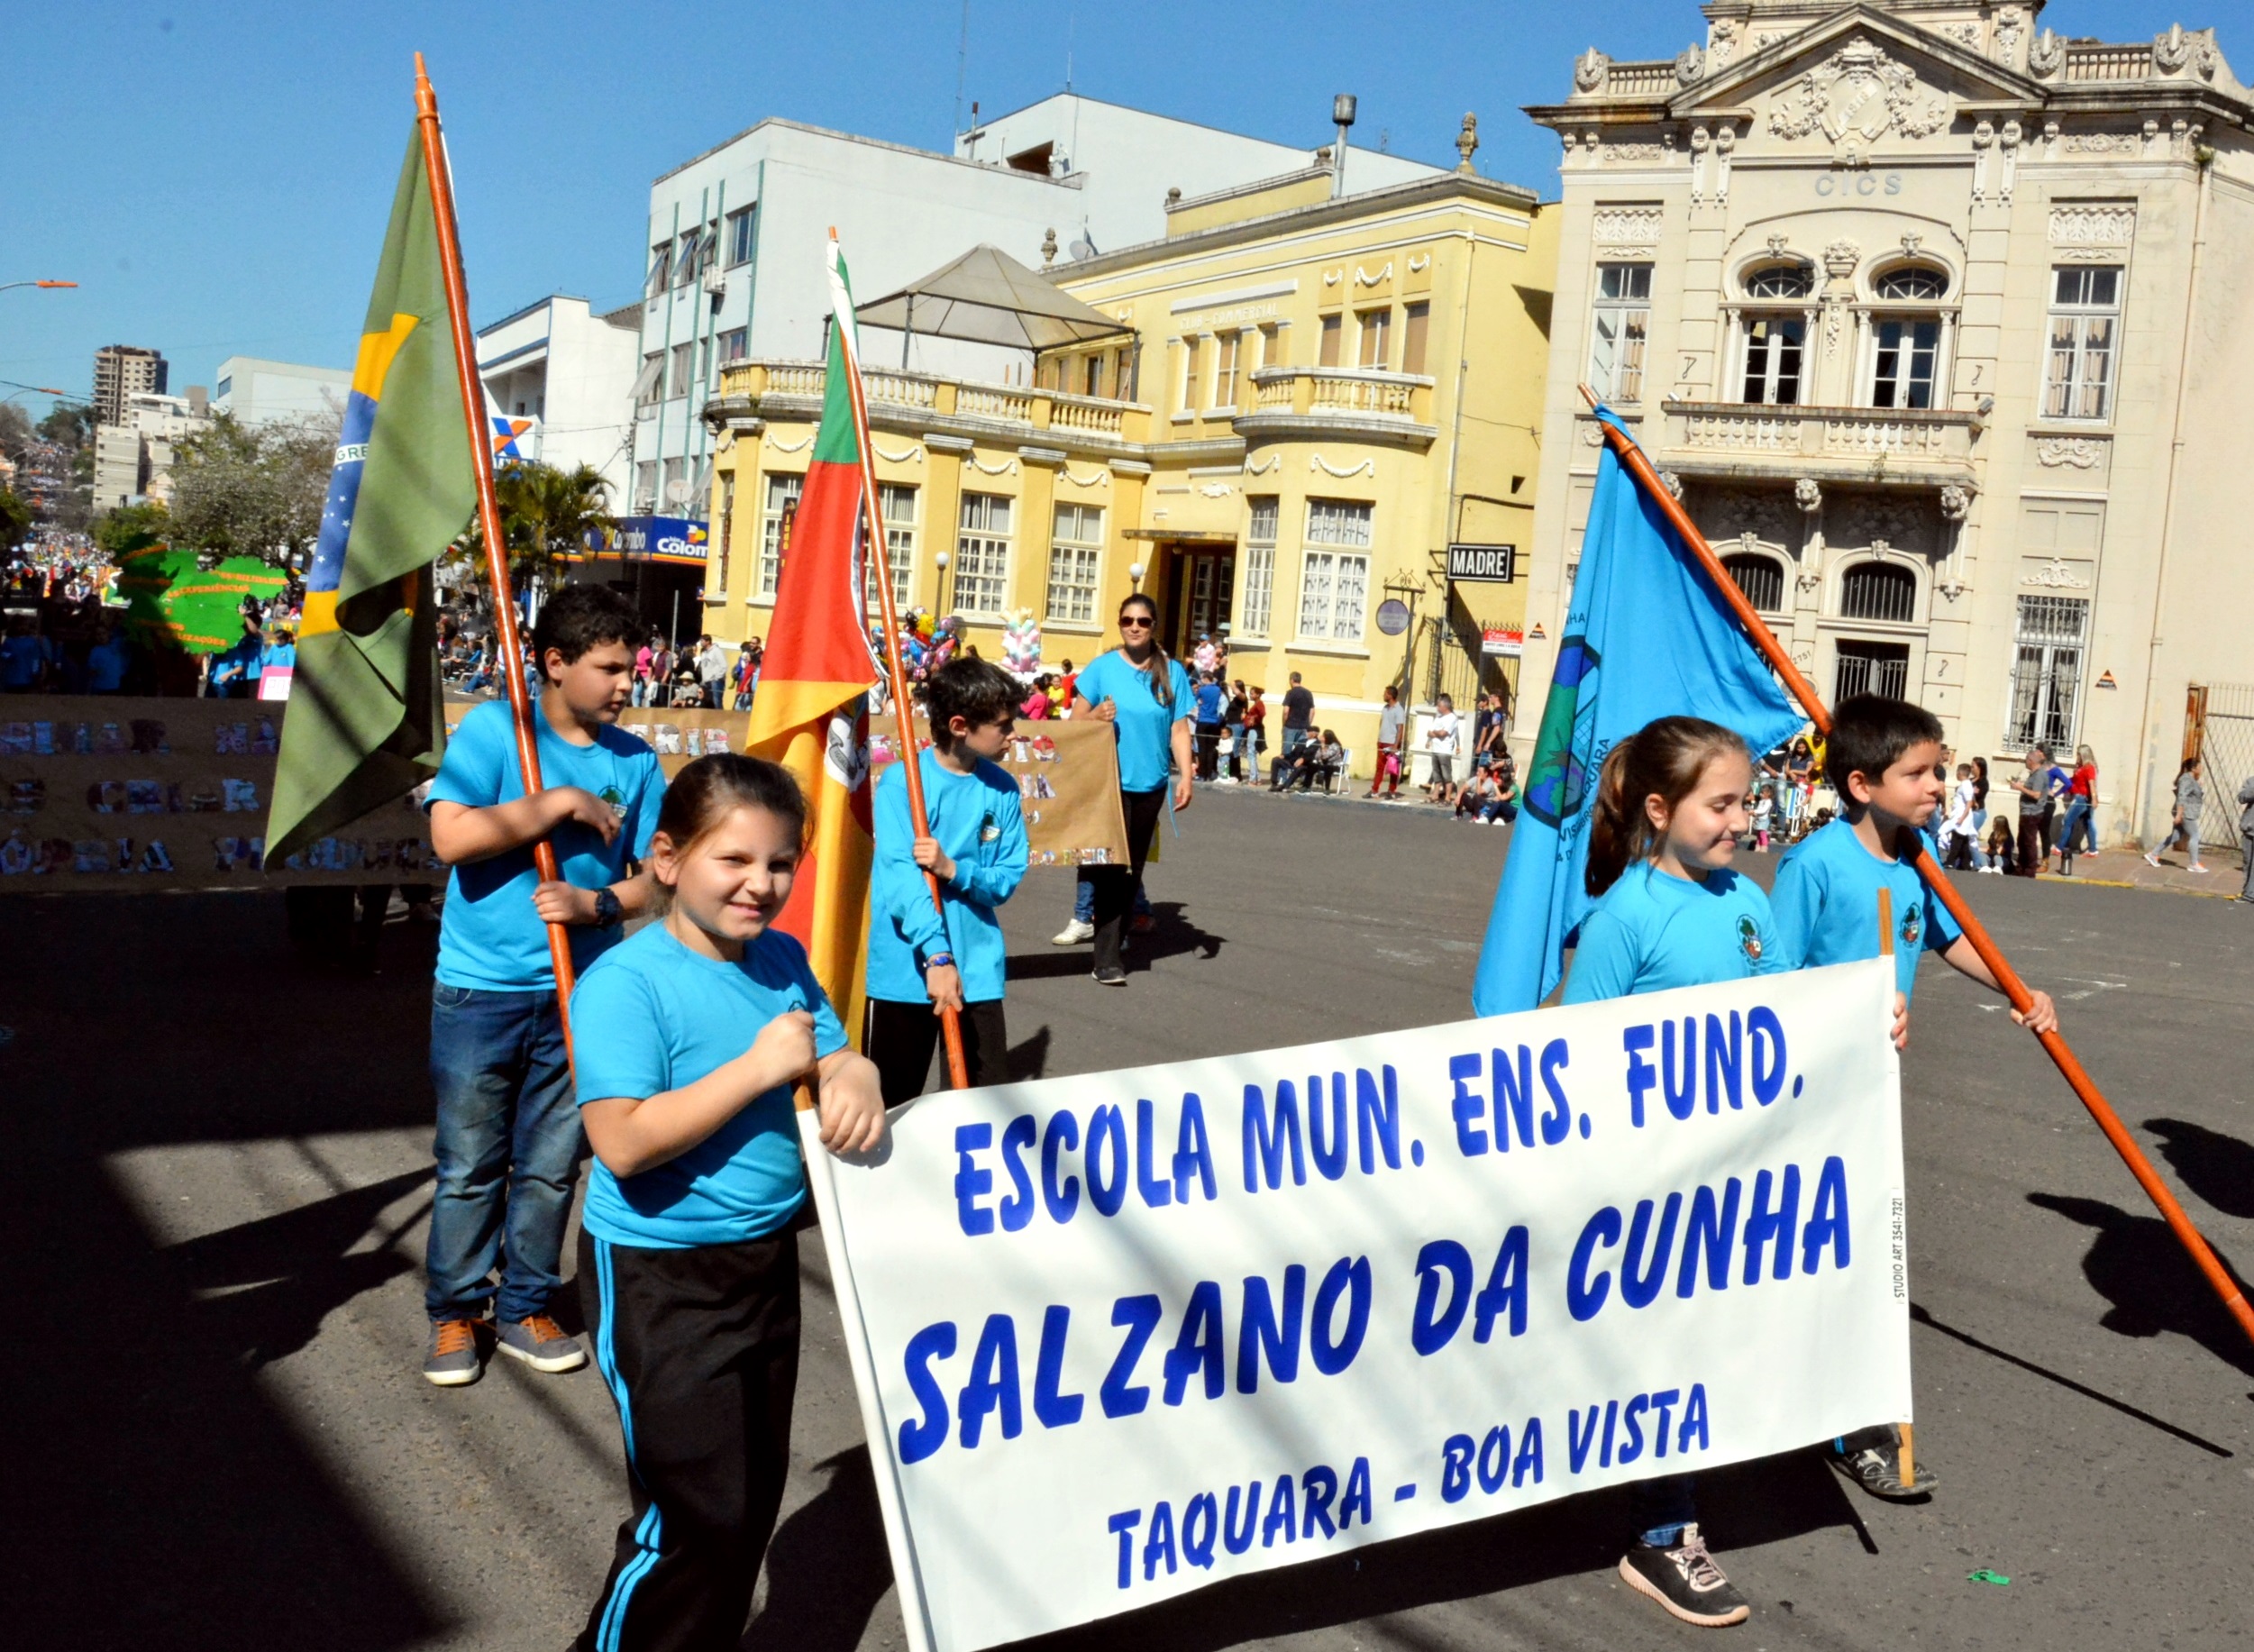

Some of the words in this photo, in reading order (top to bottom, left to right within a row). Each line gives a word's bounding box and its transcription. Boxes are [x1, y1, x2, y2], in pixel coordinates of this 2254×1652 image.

[1815, 170, 1903, 196] CICS
[1180, 315, 1203, 331] CLUB
[1213, 303, 1280, 326] COMMERCIAL
[1452, 550, 1506, 576] MADRE
[955, 1093, 1217, 1237] ESCOLA
[1243, 1065, 1424, 1193] MUN.
[1450, 1039, 1592, 1157] ENS.
[1624, 1007, 1803, 1127] FUND.
[1892, 1198, 1903, 1241] 3541-7321
[1892, 1243, 1903, 1261] ART
[1893, 1264, 1905, 1298] STUDIO
[899, 1256, 1373, 1465] SALZANO
[1412, 1226, 1529, 1356] DA
[1567, 1156, 1850, 1322] CUNHA
[1109, 1456, 1372, 1589] TAQUARA
[1442, 1419, 1544, 1503] BOA
[1569, 1383, 1709, 1474] VISTA
